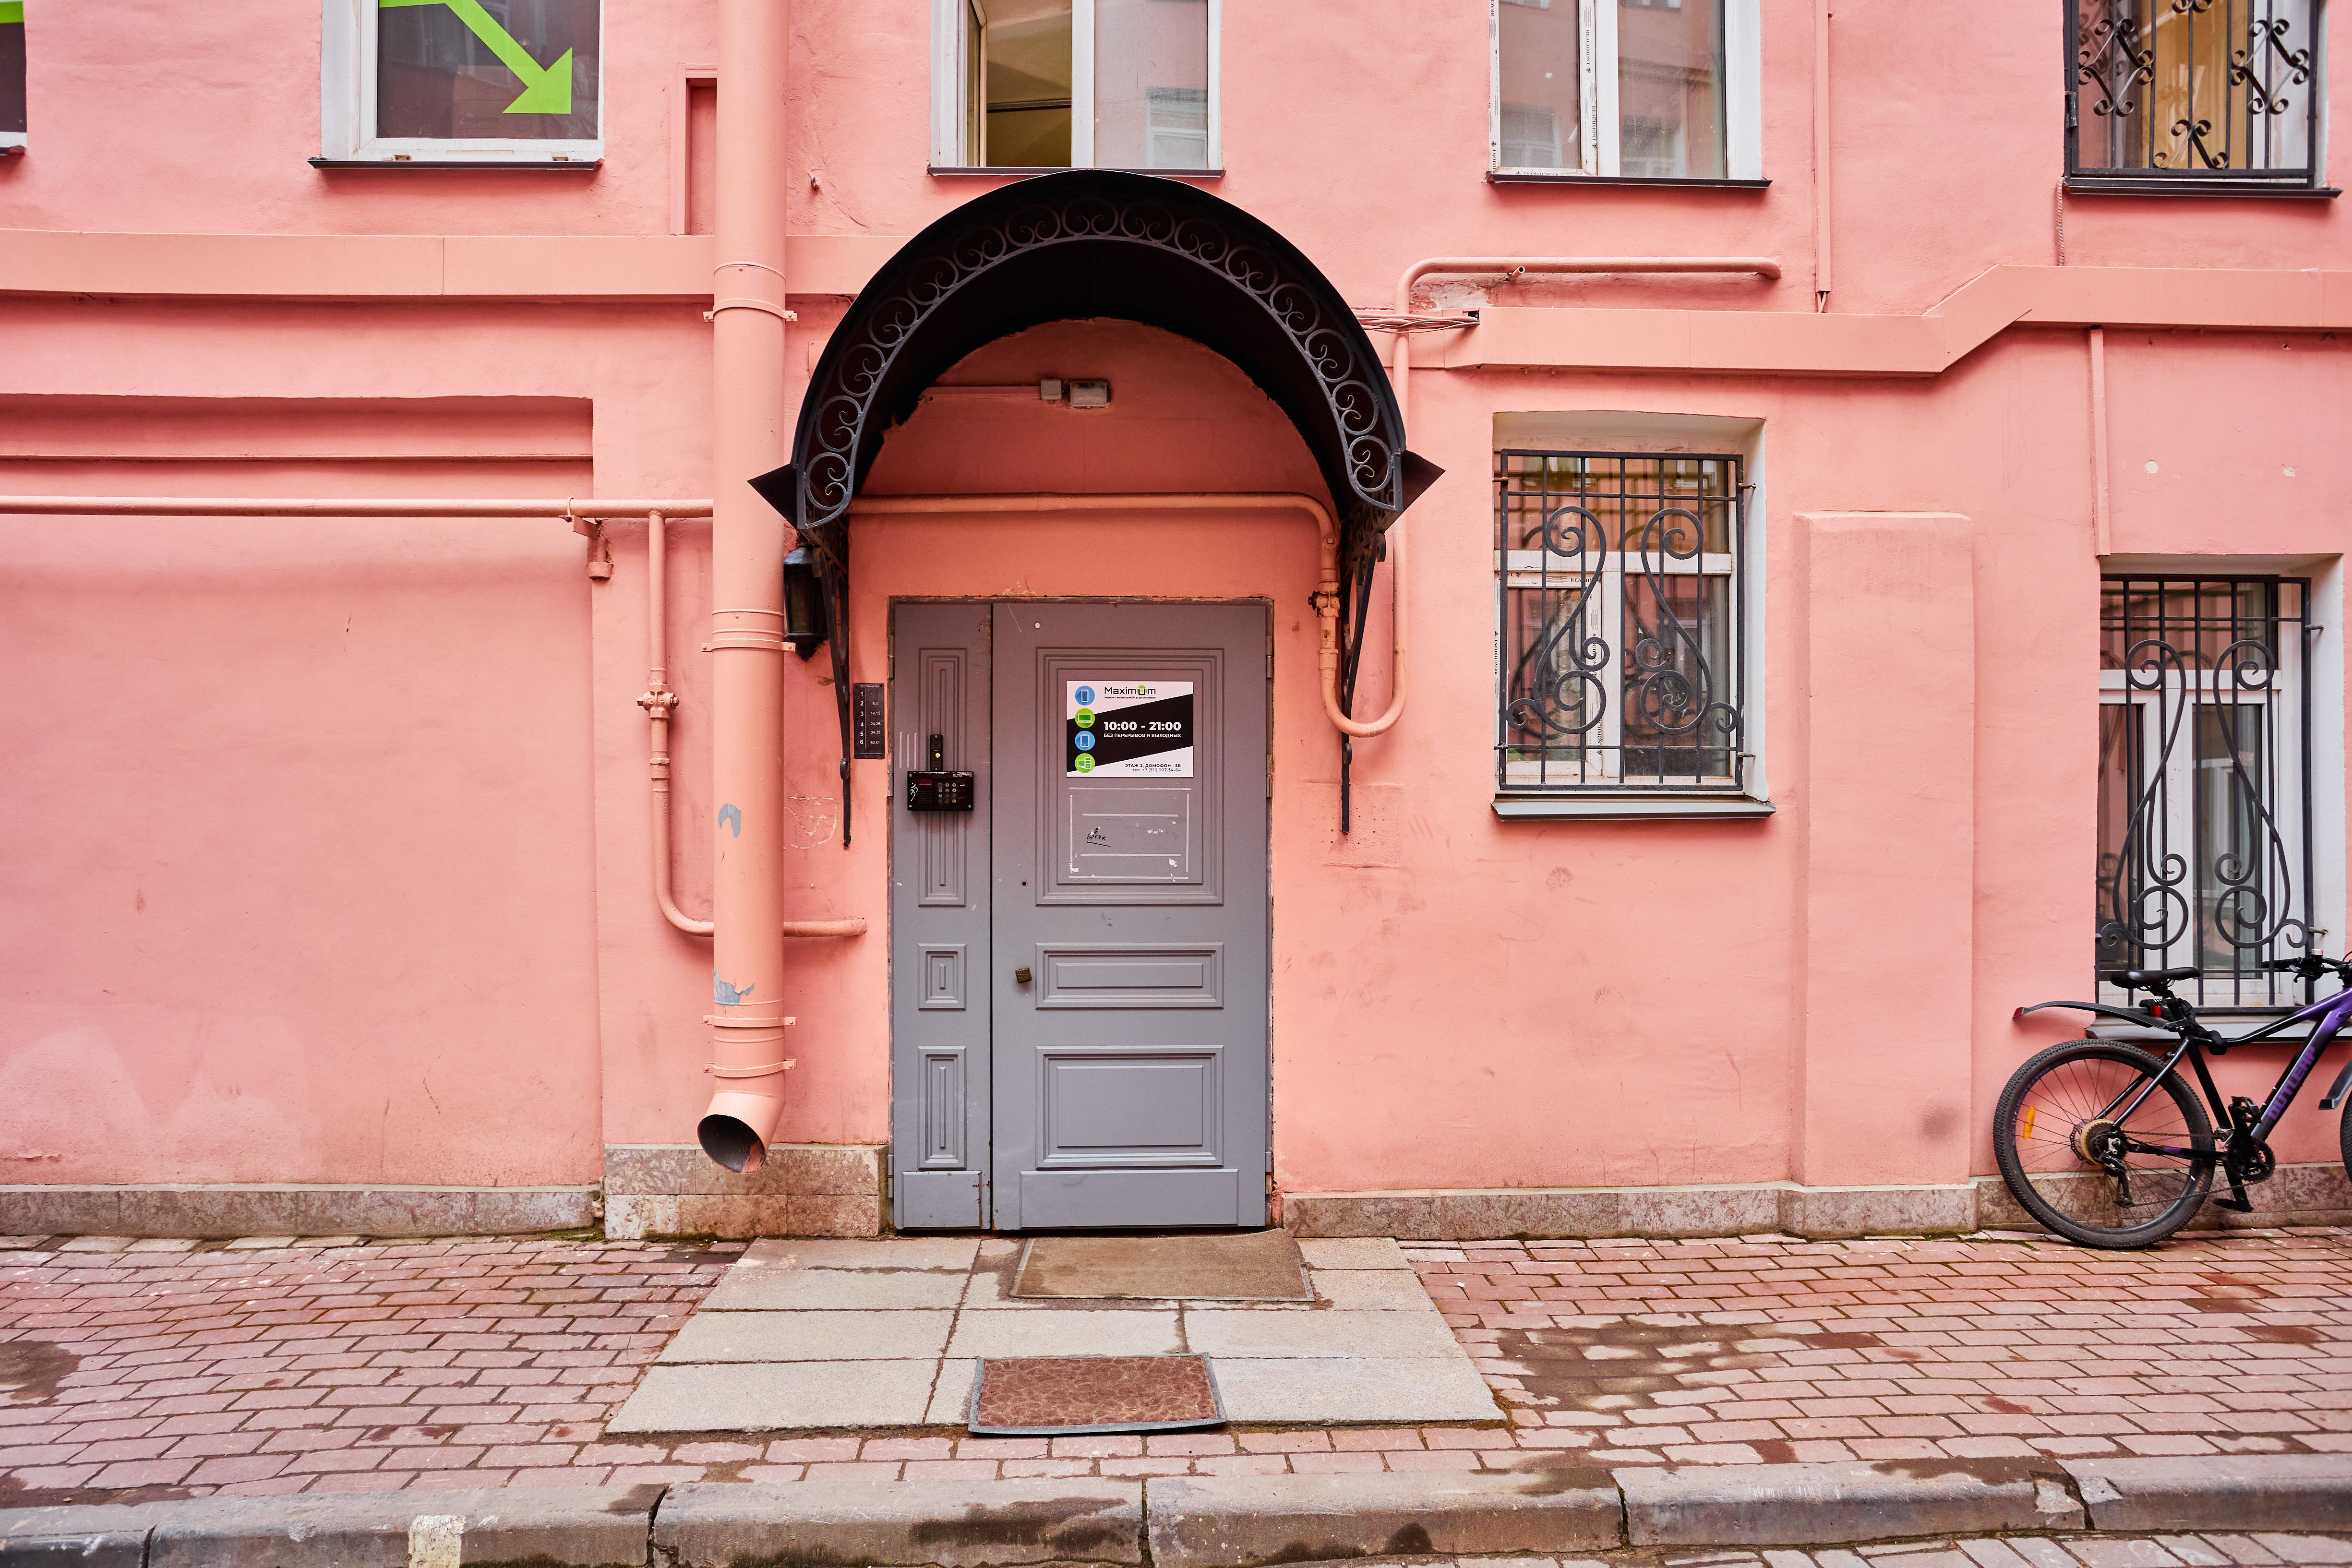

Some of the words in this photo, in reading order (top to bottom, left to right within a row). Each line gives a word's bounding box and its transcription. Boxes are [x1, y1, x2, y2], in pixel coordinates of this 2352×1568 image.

[1104, 686, 1156, 695] Maximum
[1104, 721, 1137, 730] 10:00
[1149, 721, 1181, 730] 21:00
[2266, 1045, 2316, 1120] OUTLEAP
